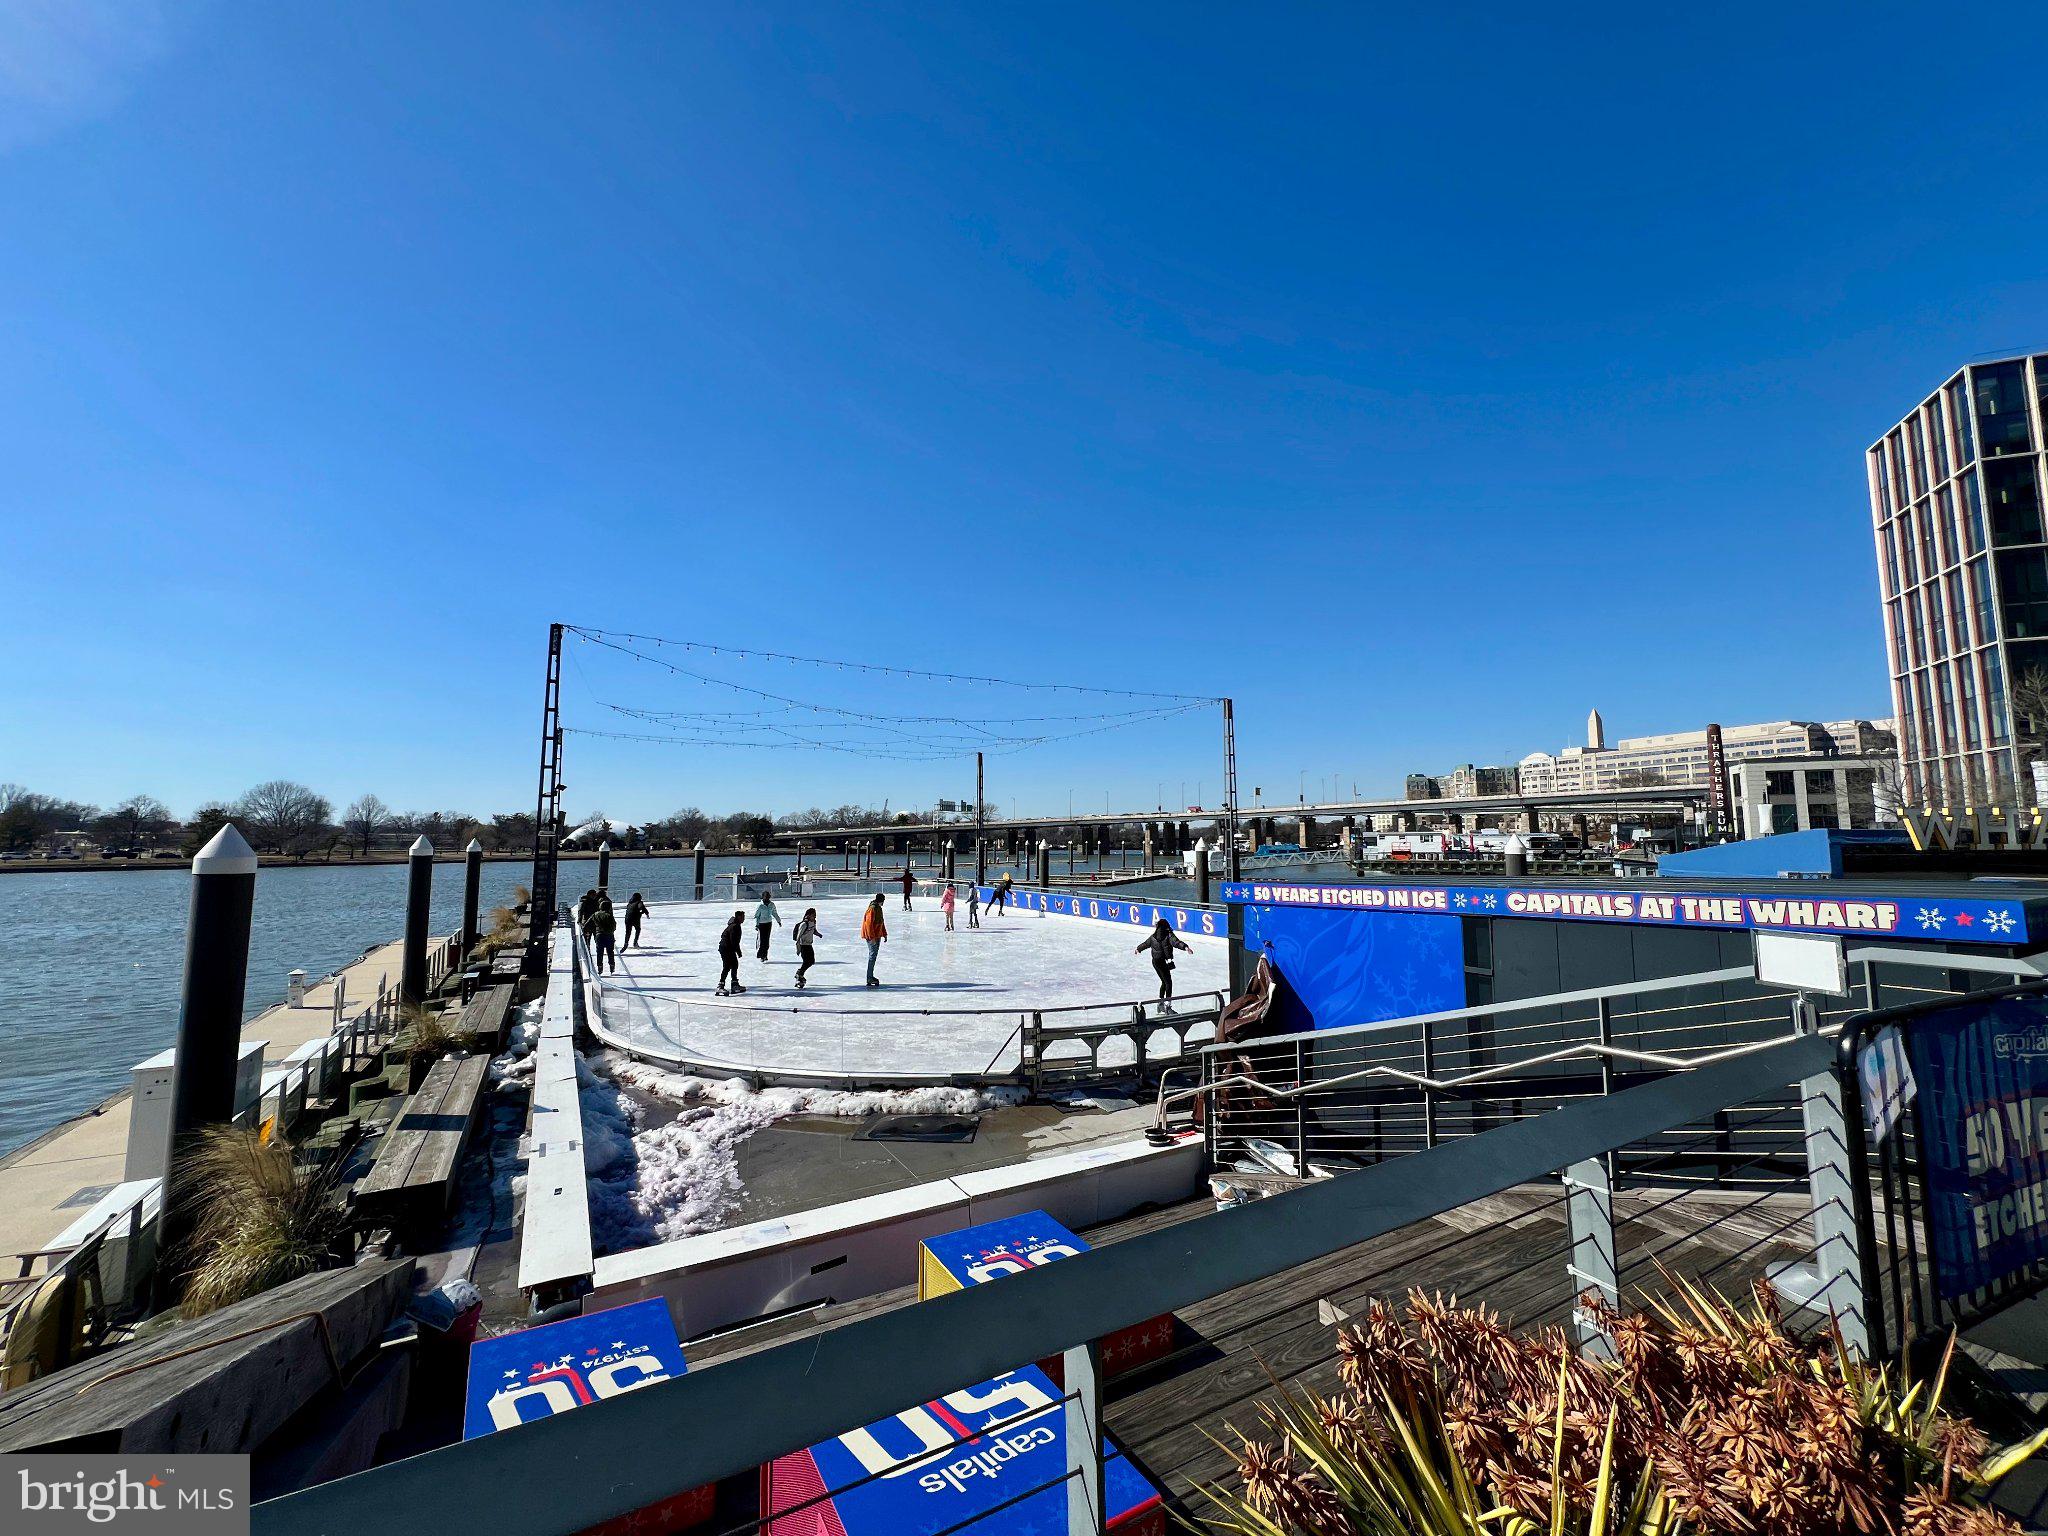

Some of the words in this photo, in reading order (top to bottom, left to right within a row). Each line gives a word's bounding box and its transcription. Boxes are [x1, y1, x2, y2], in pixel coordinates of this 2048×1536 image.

[1711, 734, 1725, 807] THRASHERS
[1717, 811, 1727, 832] RUM
[1011, 894, 1047, 911] ETS
[1071, 899, 1099, 918] GO
[1130, 905, 1214, 934] CAPS
[1253, 886, 1270, 901] 50
[1272, 887, 1320, 904] YEARS
[1322, 888, 1385, 906] ETCHED
[1388, 890, 1409, 908] IN
[1412, 891, 1447, 909] ICE
[1506, 893, 1634, 918] CAPITALS
[1639, 896, 1676, 920] AT
[1680, 898, 1743, 922] THE
[1747, 899, 1896, 930] WHARF
[1966, 1107, 2005, 1177] 50
[1973, 1179, 2048, 1249] ETCHE
[918, 1427, 1056, 1494] capitals
